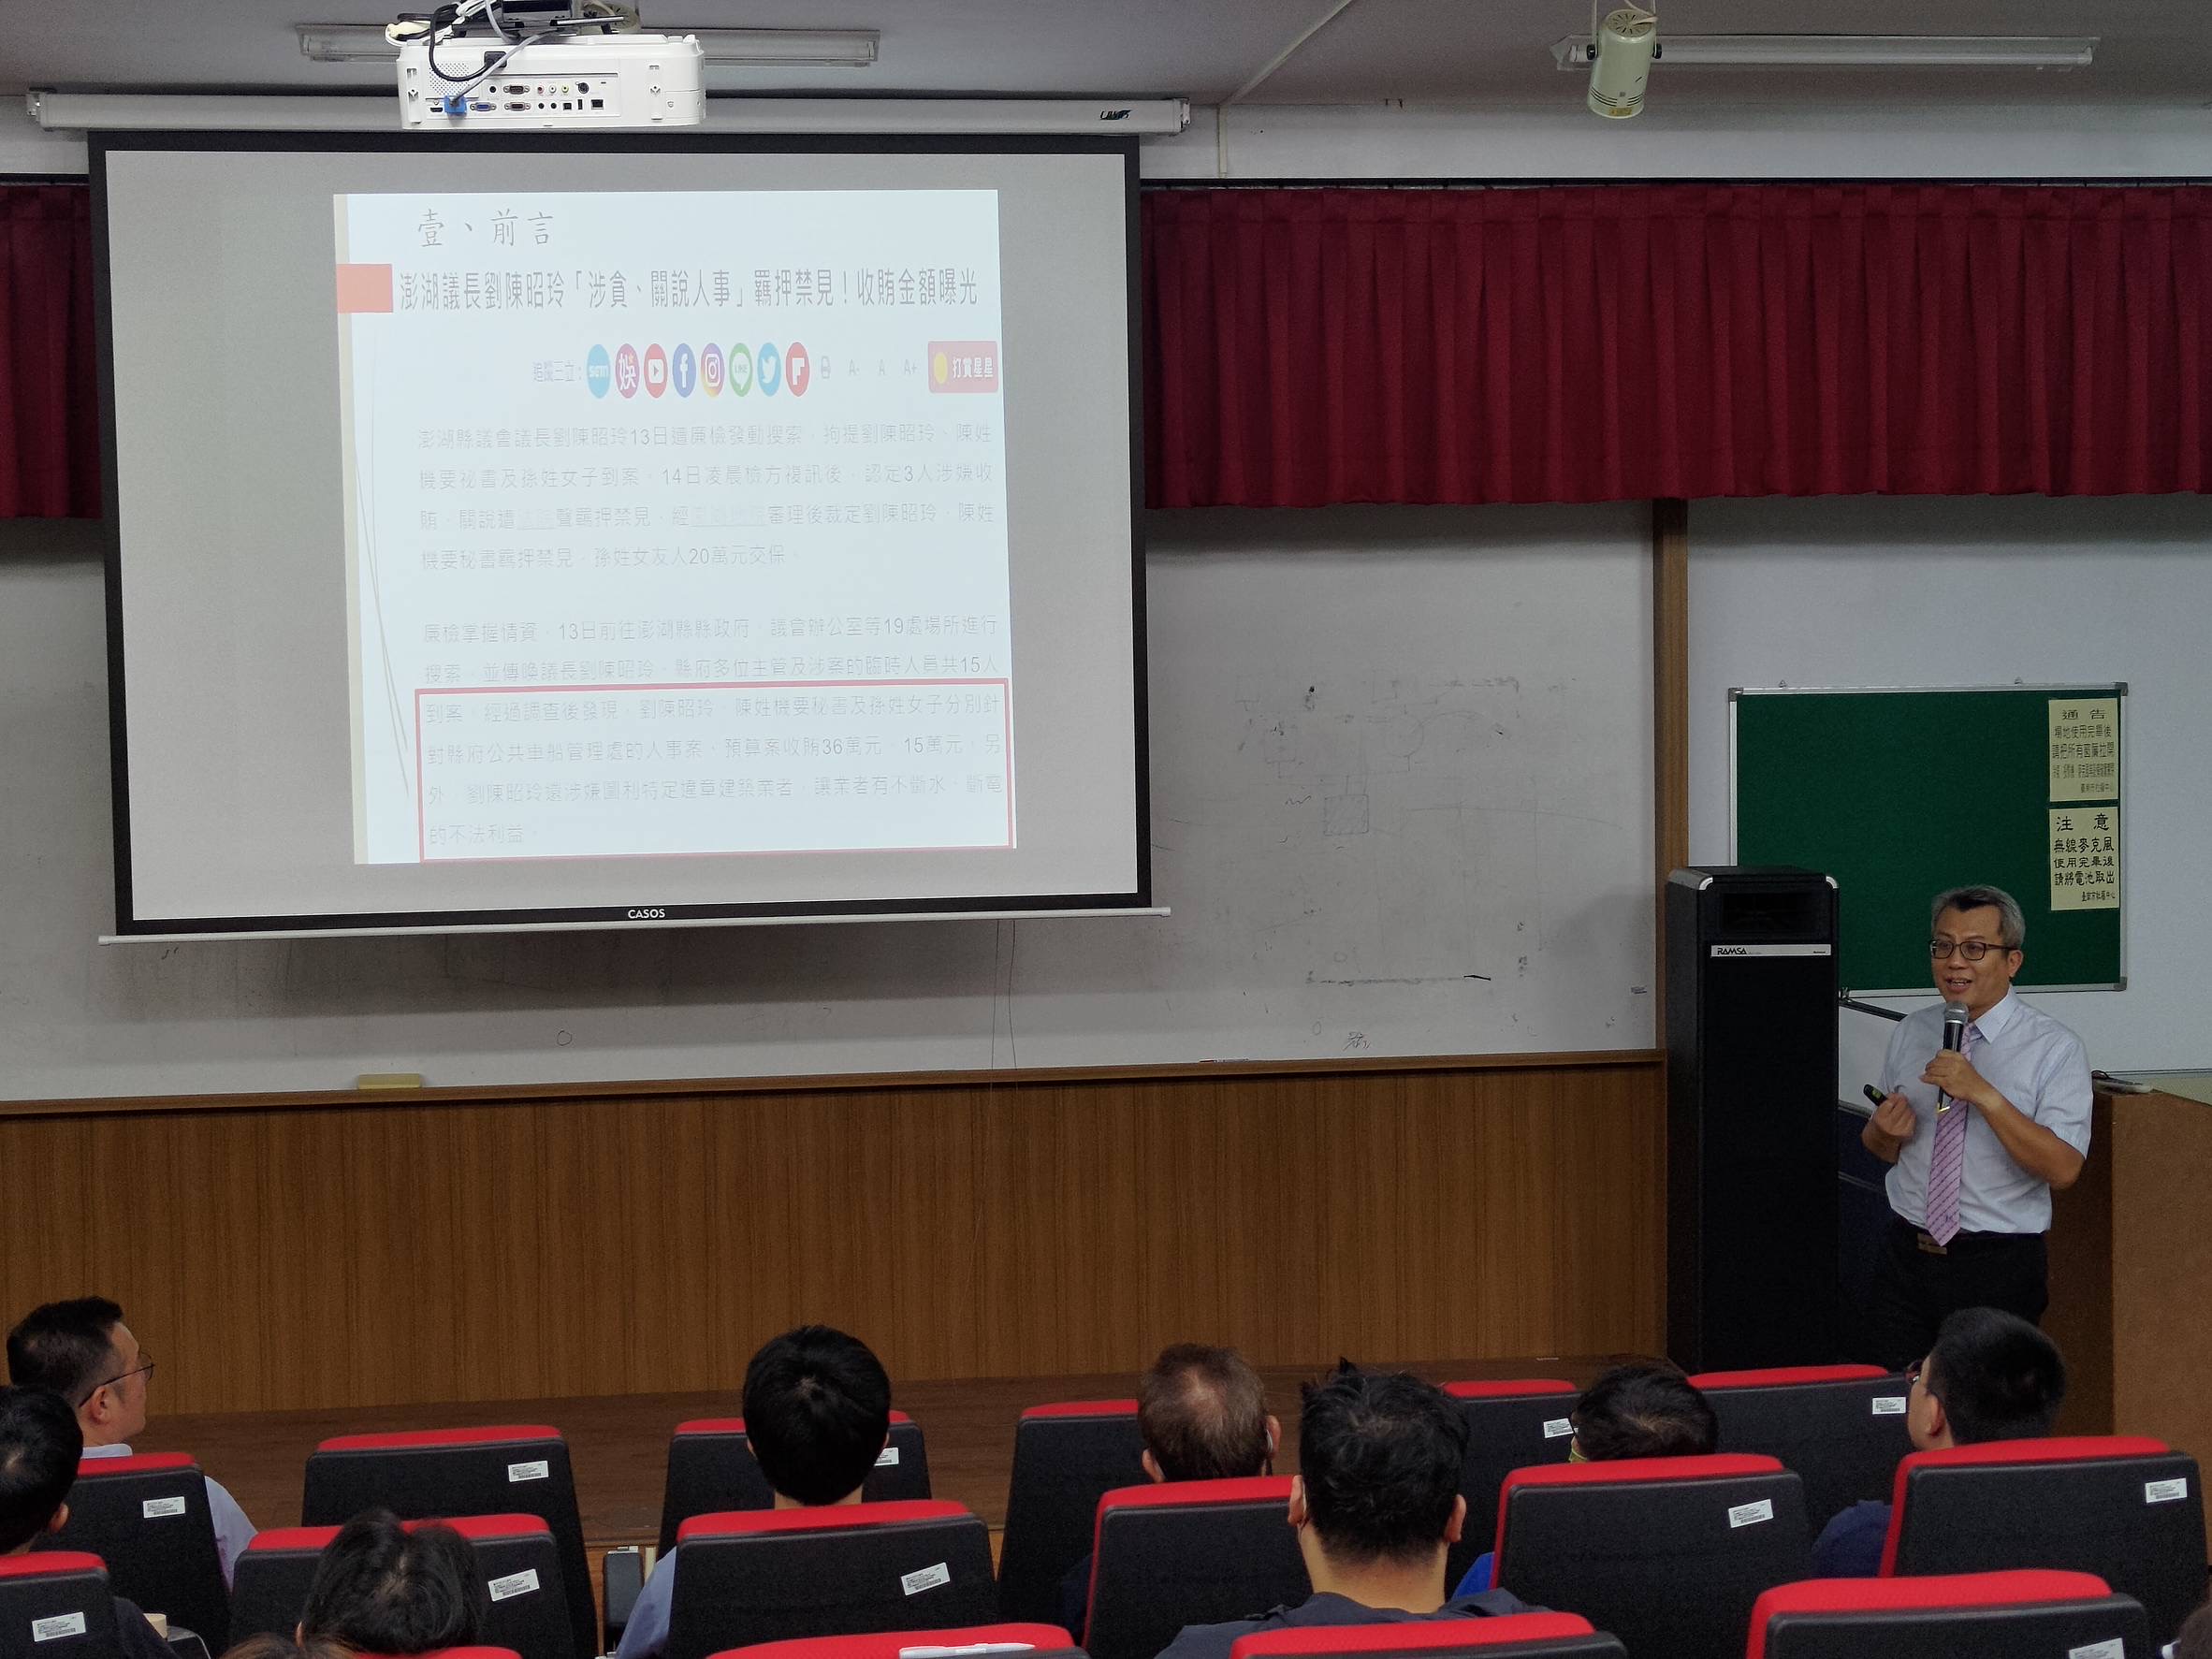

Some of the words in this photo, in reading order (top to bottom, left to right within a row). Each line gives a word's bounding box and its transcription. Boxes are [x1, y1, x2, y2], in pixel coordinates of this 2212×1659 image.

[417, 208, 554, 247] 壹、前言
[2056, 812, 2110, 832] 注意
[2054, 837, 2115, 853] 無線麥克風
[2053, 856, 2115, 868] 使用完畢後
[2054, 870, 2115, 886] 請將電池取出
[628, 909, 666, 919] CASOS
[1717, 947, 1747, 955] RAMSA
